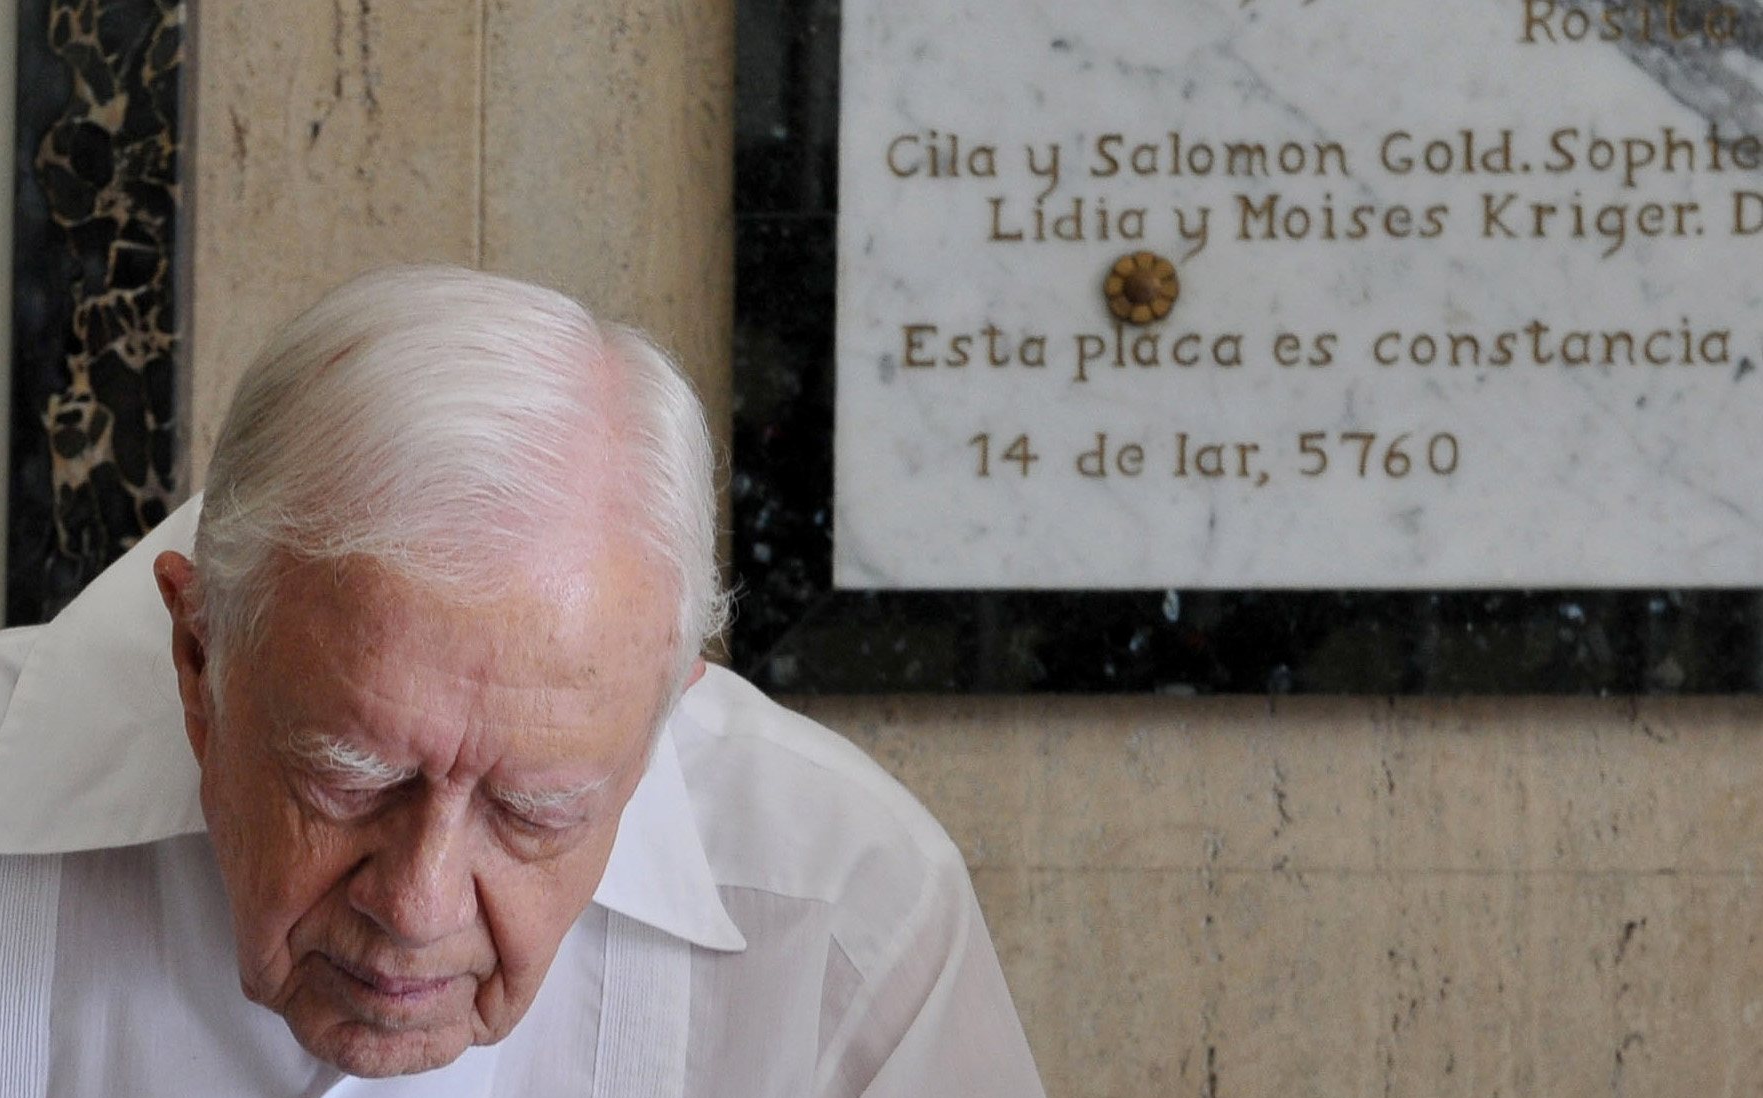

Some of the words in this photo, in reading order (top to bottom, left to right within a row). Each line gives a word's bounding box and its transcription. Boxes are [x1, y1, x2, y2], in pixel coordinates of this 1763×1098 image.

[886, 130, 999, 179] Cila
[1026, 142, 1061, 199] y
[1089, 129, 1354, 178] Salomon
[987, 196, 1149, 244] Lidia
[1174, 203, 1212, 261] y
[1235, 193, 1450, 242] Moises
[1480, 191, 1707, 259] Kriger.
[898, 321, 1050, 370] Esta
[1071, 318, 1244, 383] placa
[1271, 333, 1338, 369] es
[966, 431, 1040, 480] 14
[1075, 429, 1148, 481] de
[1296, 429, 1462, 480] 5760
